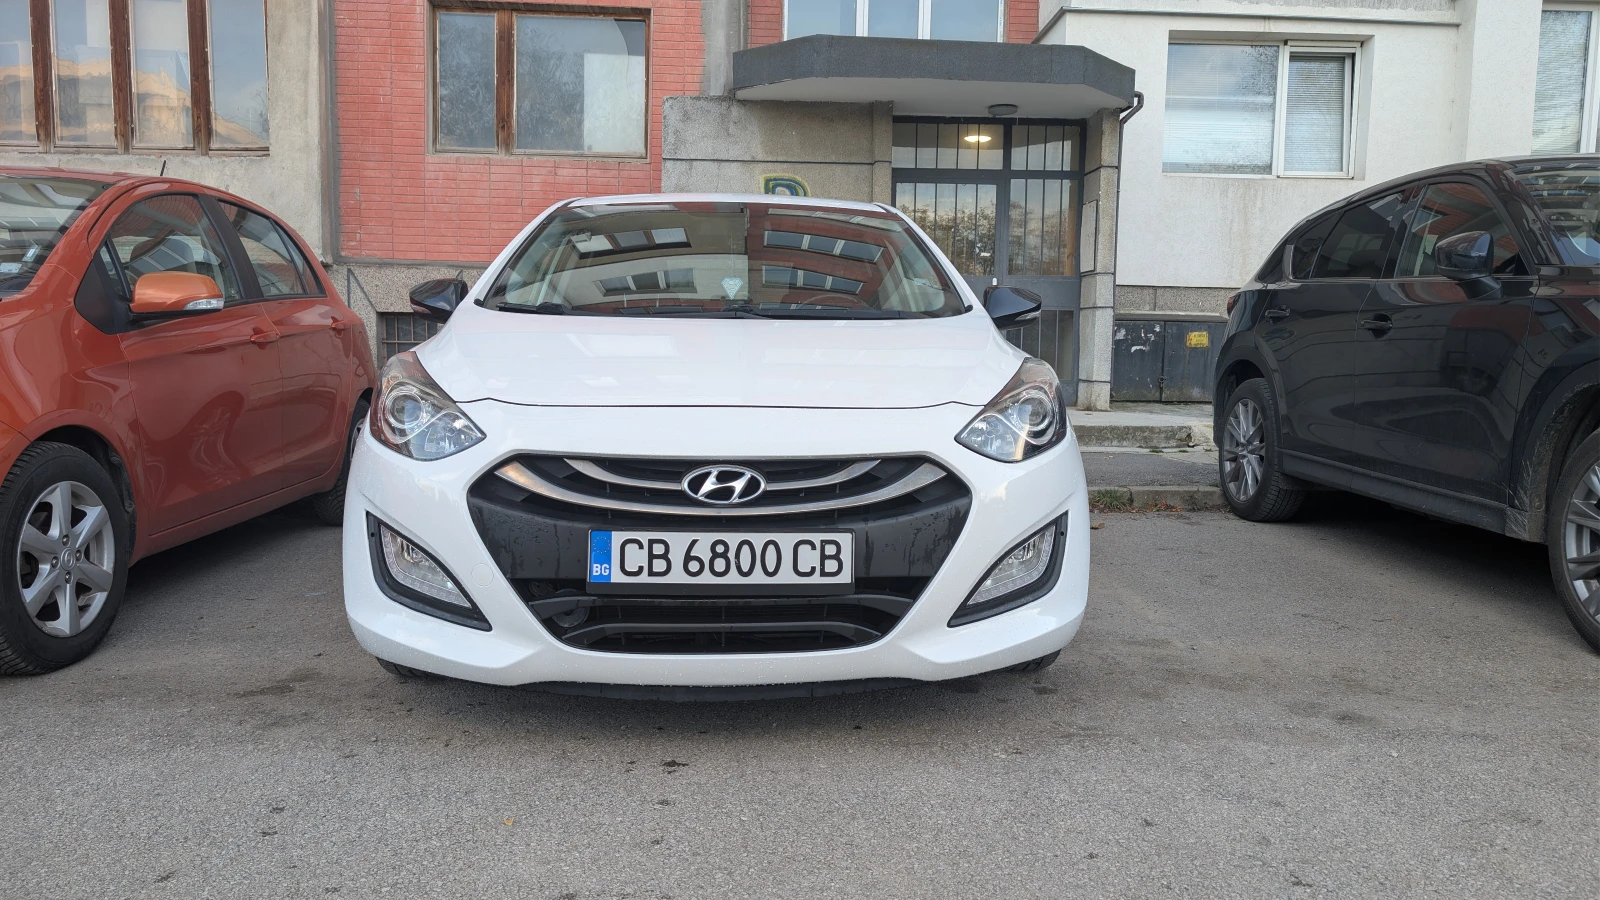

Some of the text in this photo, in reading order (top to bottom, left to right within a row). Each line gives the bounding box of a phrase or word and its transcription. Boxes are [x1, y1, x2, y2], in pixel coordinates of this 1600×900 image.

[592, 563, 610, 576] BG
[619, 538, 844, 578] CB 6800 CB
